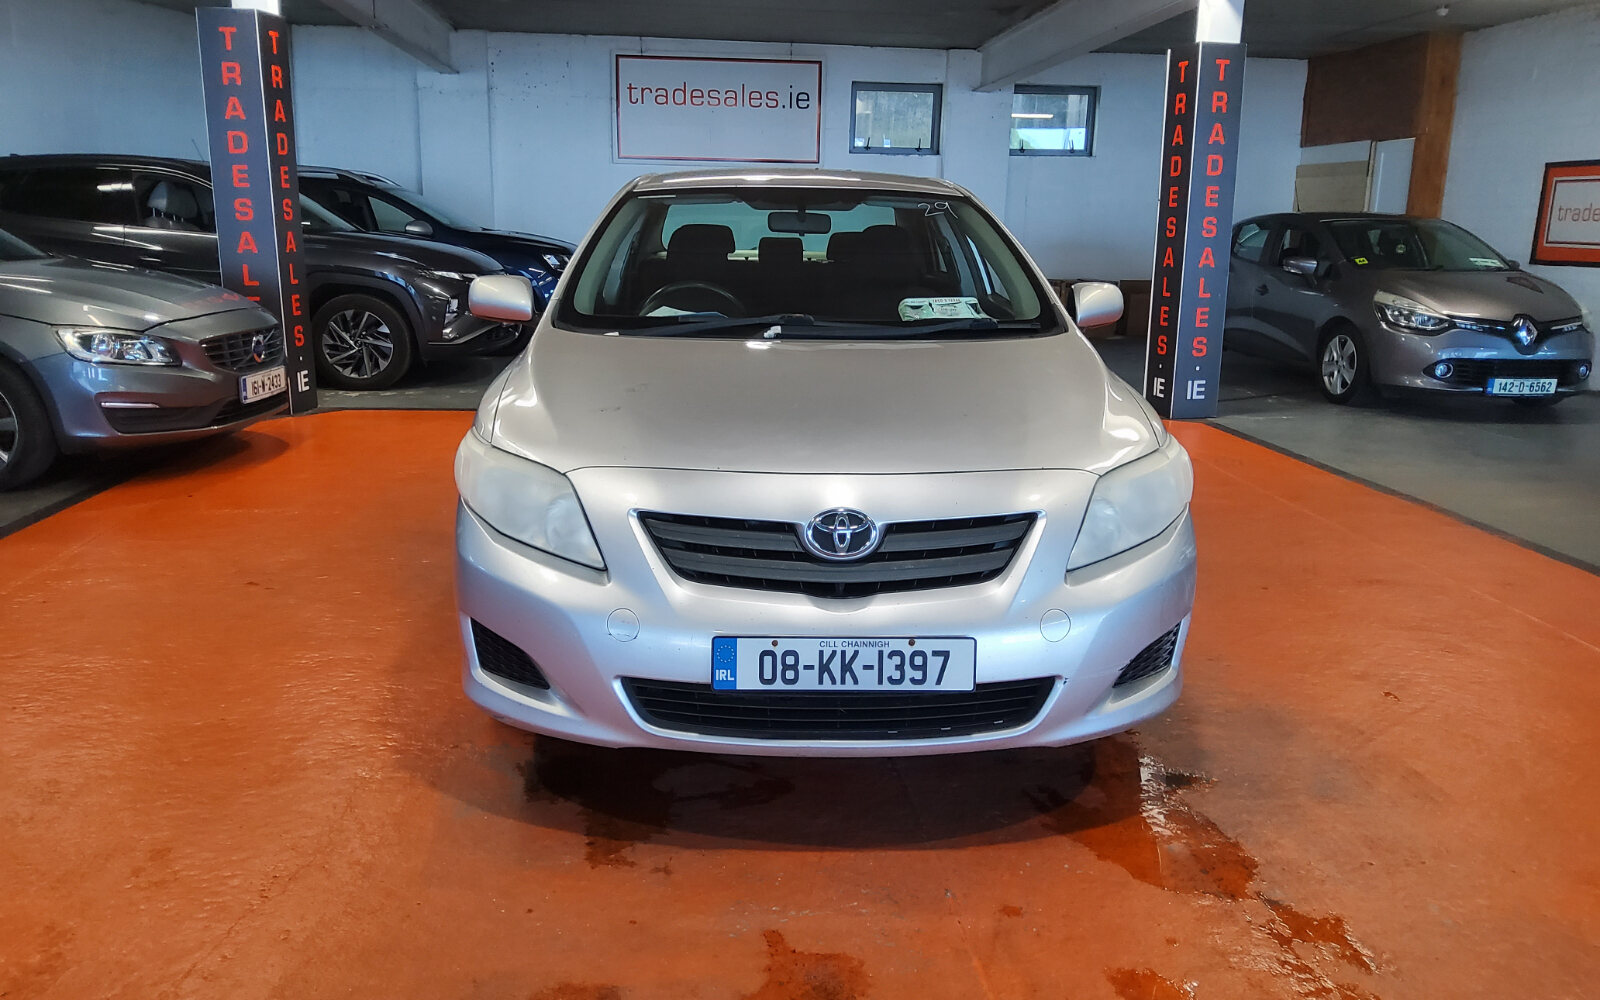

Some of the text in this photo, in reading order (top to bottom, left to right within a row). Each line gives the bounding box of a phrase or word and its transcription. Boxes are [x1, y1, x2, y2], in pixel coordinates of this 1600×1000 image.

[627, 81, 810, 110] tradesales.ie
[218, 26, 260, 301] TRADESAL
[251, 374, 281, 396] 161-W-2433
[1498, 381, 1553, 393] 142-D-6562
[819, 640, 890, 648] CILL CHAINNIGH
[715, 669, 735, 681] IRL
[758, 649, 951, 686] 08-KK-1397
